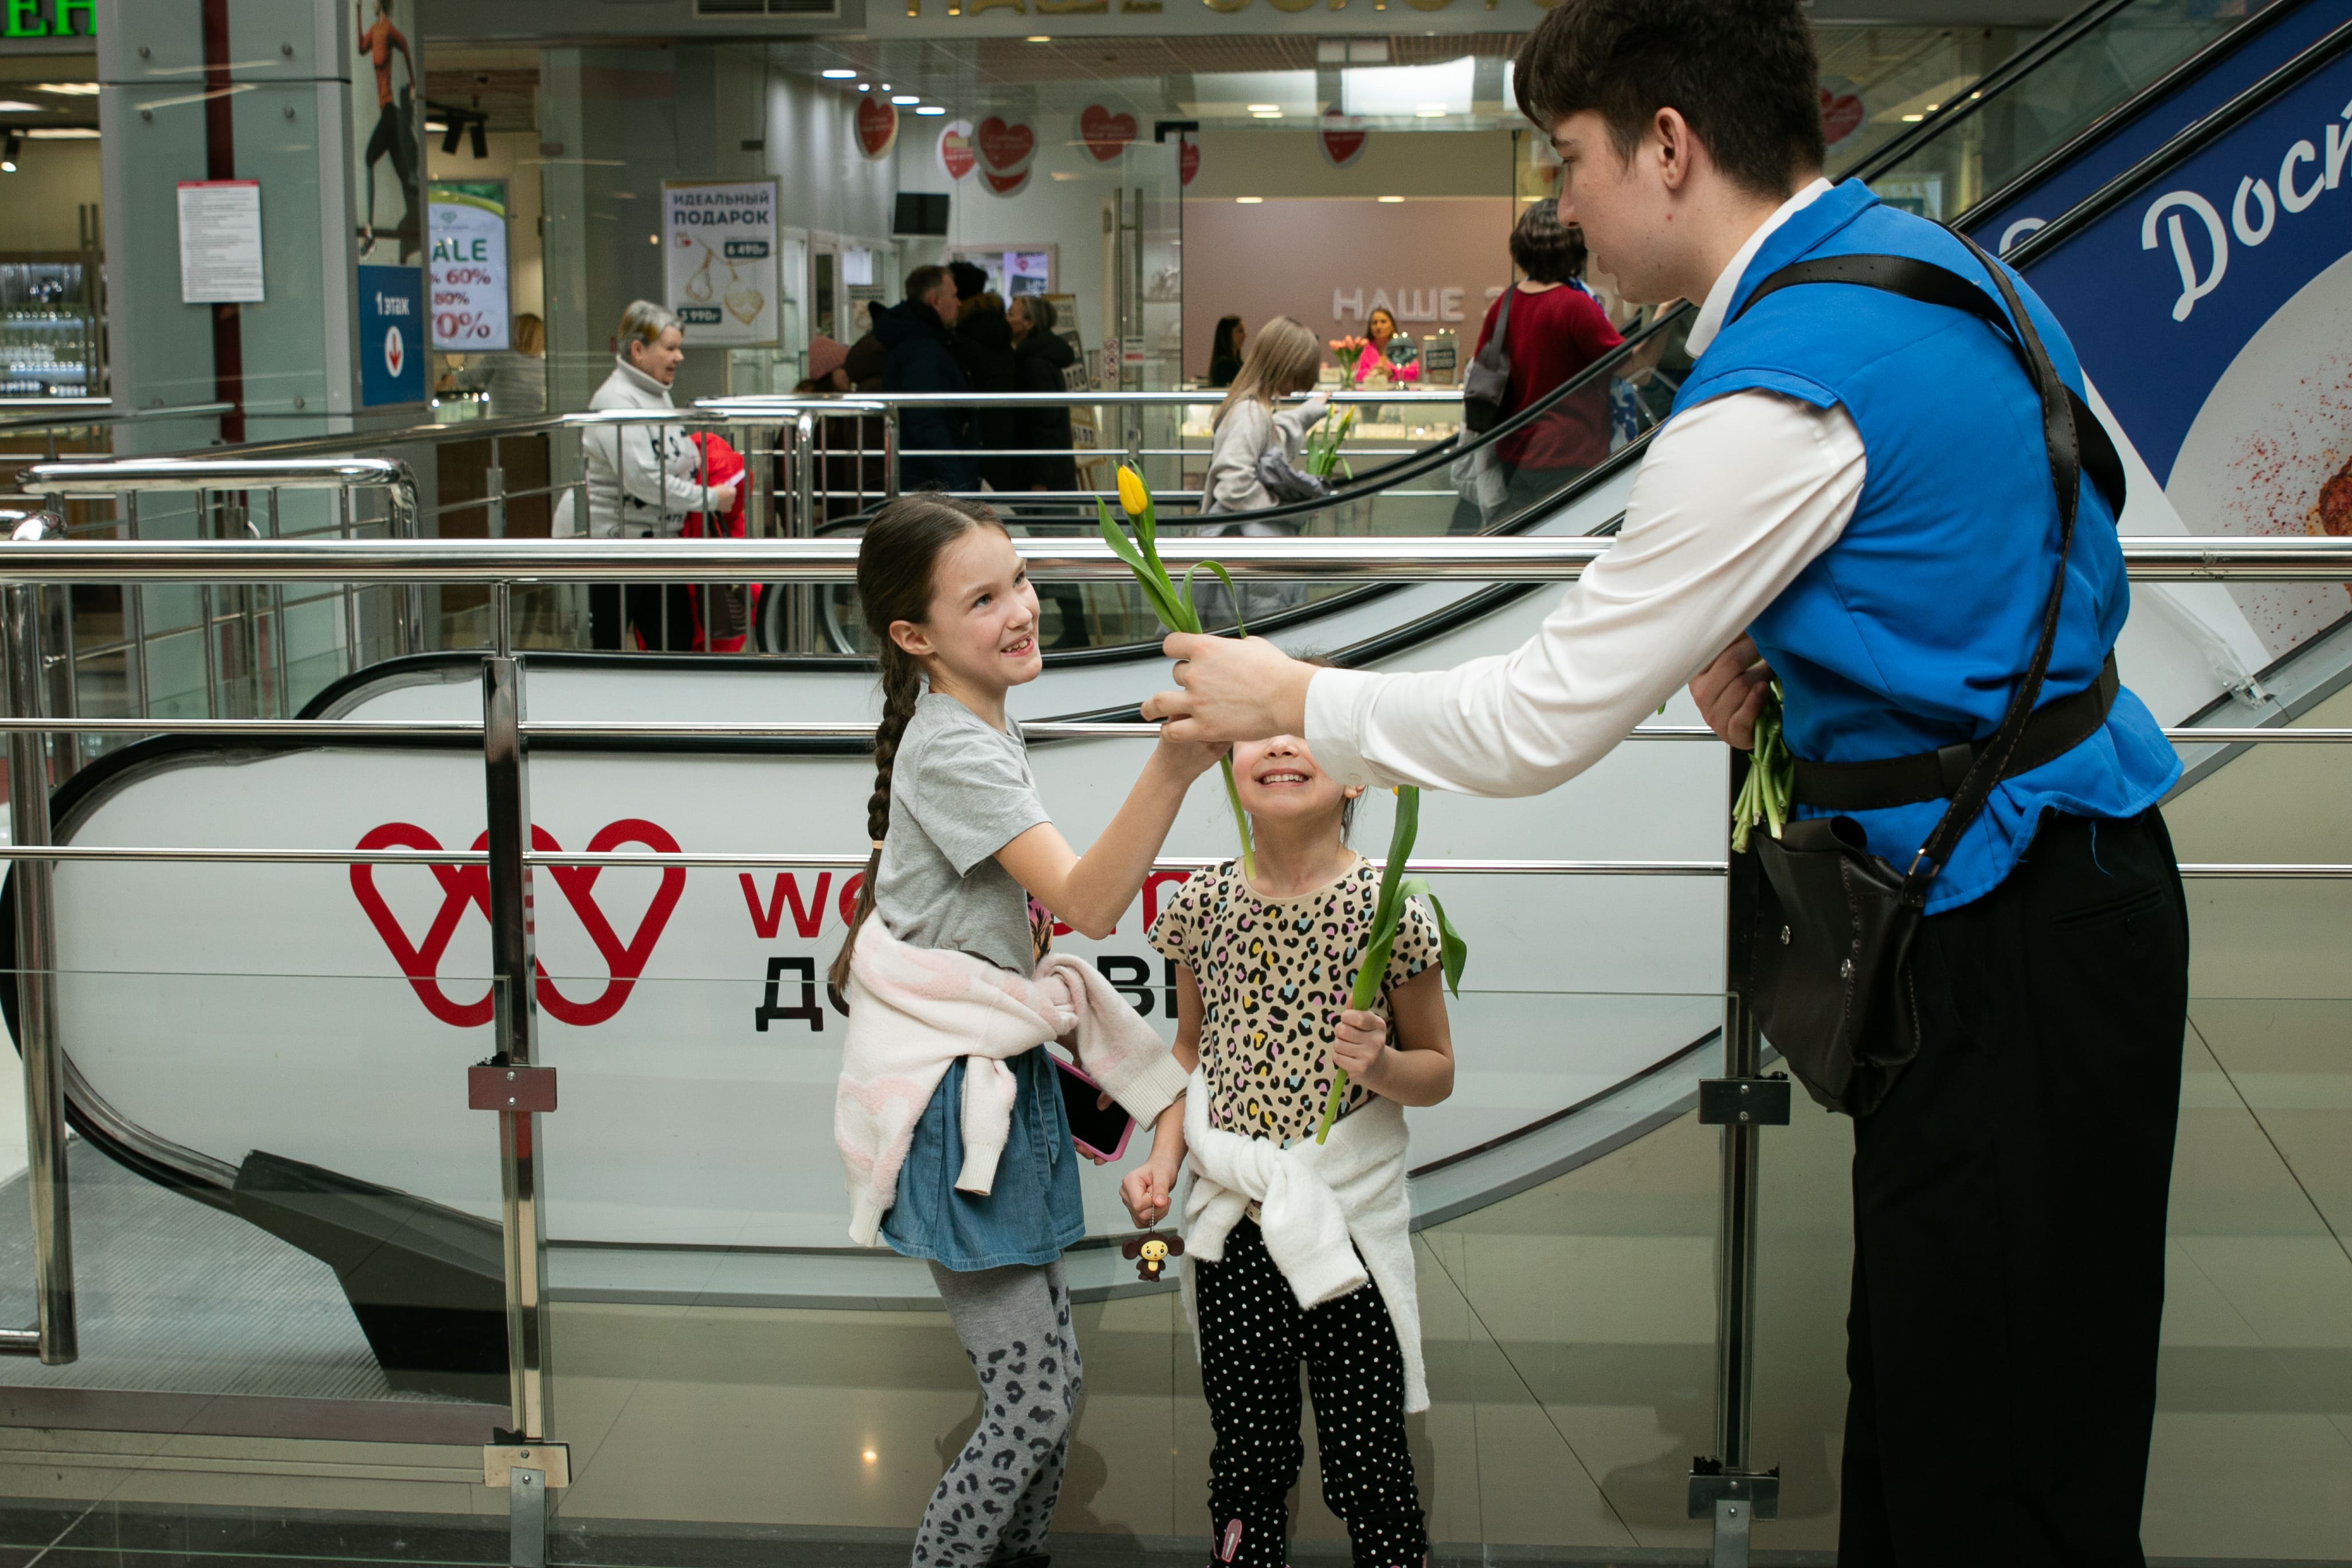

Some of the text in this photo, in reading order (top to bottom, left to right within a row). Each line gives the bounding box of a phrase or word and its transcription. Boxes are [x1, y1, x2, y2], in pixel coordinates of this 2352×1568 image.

[673, 190, 769, 205] ИДЕАЛЬНЫЙ
[673, 210, 769, 225] ПОДАРОК
[432, 237, 488, 261] ALE
[446, 268, 491, 285] 60%
[375, 291, 410, 315] 1 этаж
[1332, 287, 1465, 322] НАШЕ
[432, 311, 491, 339] 0%
